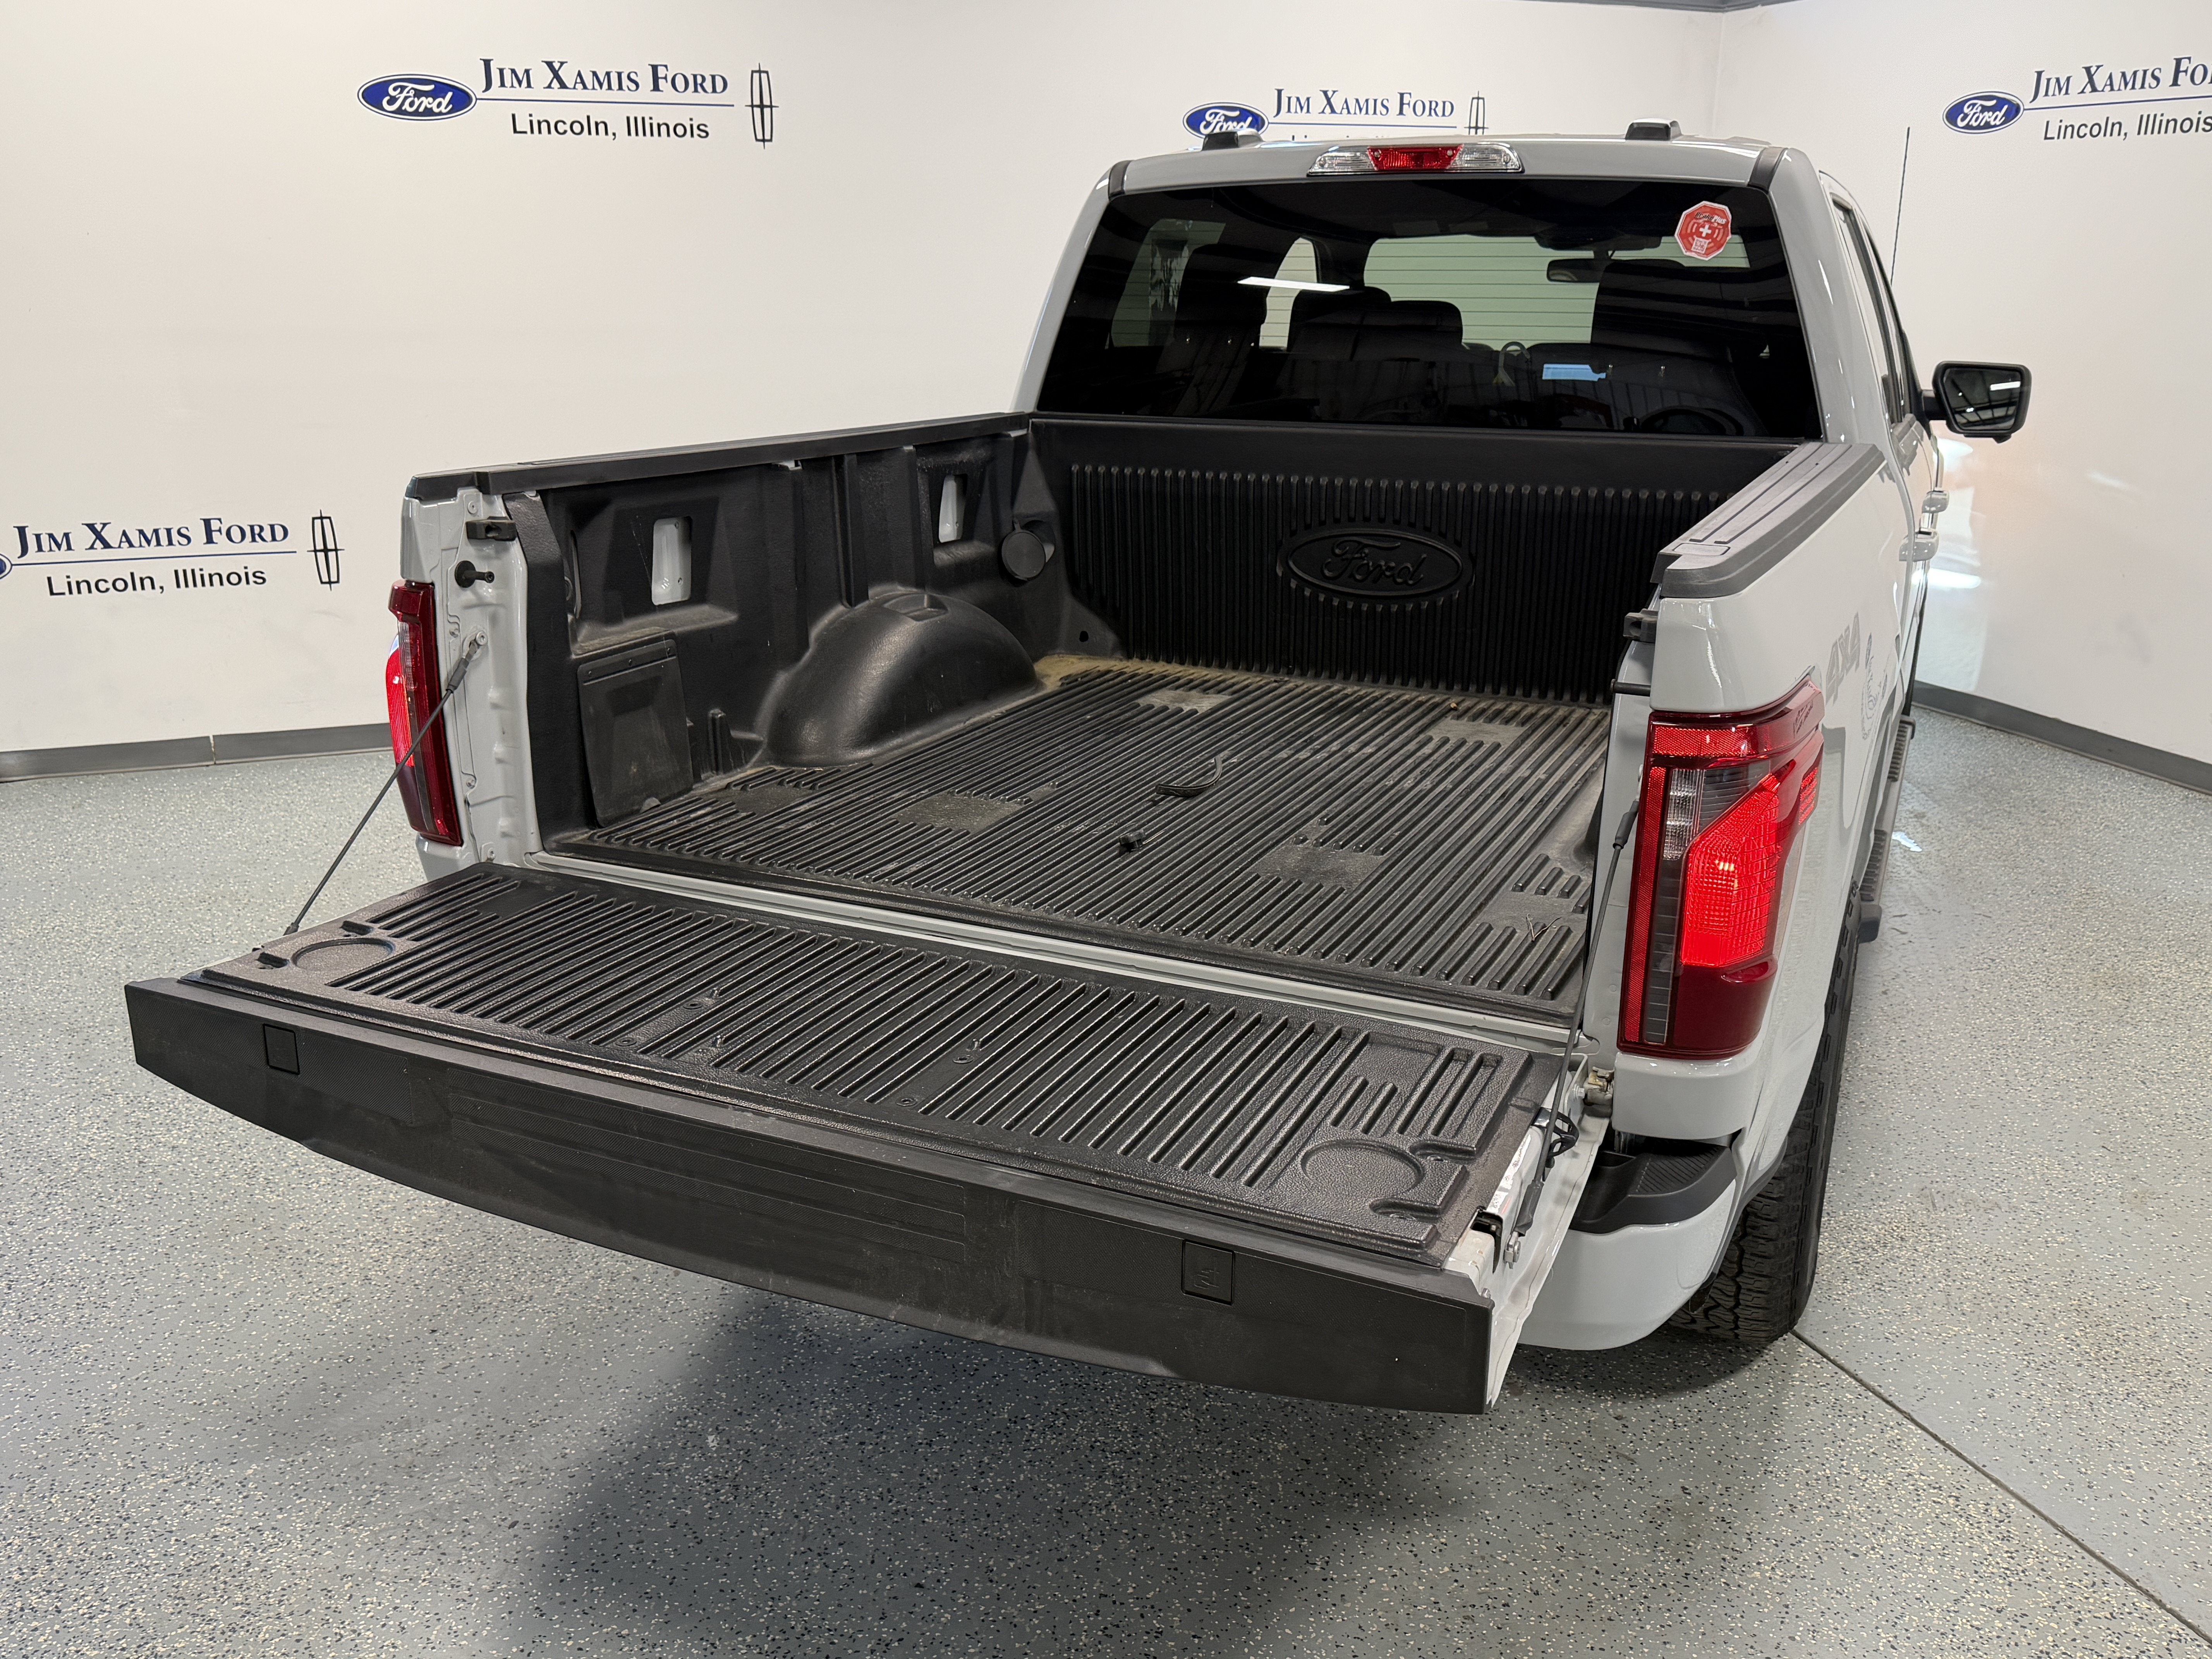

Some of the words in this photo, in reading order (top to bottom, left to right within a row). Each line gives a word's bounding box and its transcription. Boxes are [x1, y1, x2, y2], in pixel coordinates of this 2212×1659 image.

[480, 58, 534, 93] JIM
[541, 60, 639, 91] XAMIS
[648, 64, 728, 93] FORD
[2030, 70, 2072, 103] JIM
[2078, 65, 2161, 94] XAMIS
[2169, 57, 2212, 87] FO
[382, 82, 453, 114] Ford
[1273, 89, 1310, 118] JIM
[1318, 90, 1389, 116] XAMIS
[1396, 92, 1454, 117] FORD
[1957, 99, 2006, 127] Ford
[512, 113, 616, 140] Lincoln,
[627, 116, 709, 138] Illinois
[1200, 109, 1252, 134] Ford
[2044, 117, 2127, 141] Lincoln,
[2137, 111, 2212, 135] Illinois
[13, 526, 74, 558] JIM
[82, 522, 191, 550] XAMIS
[200, 518, 288, 544] FORD
[1322, 537, 1426, 584] Ford
[47, 572, 164, 596] Lincoln,
[174, 566, 266, 588] Illinois
